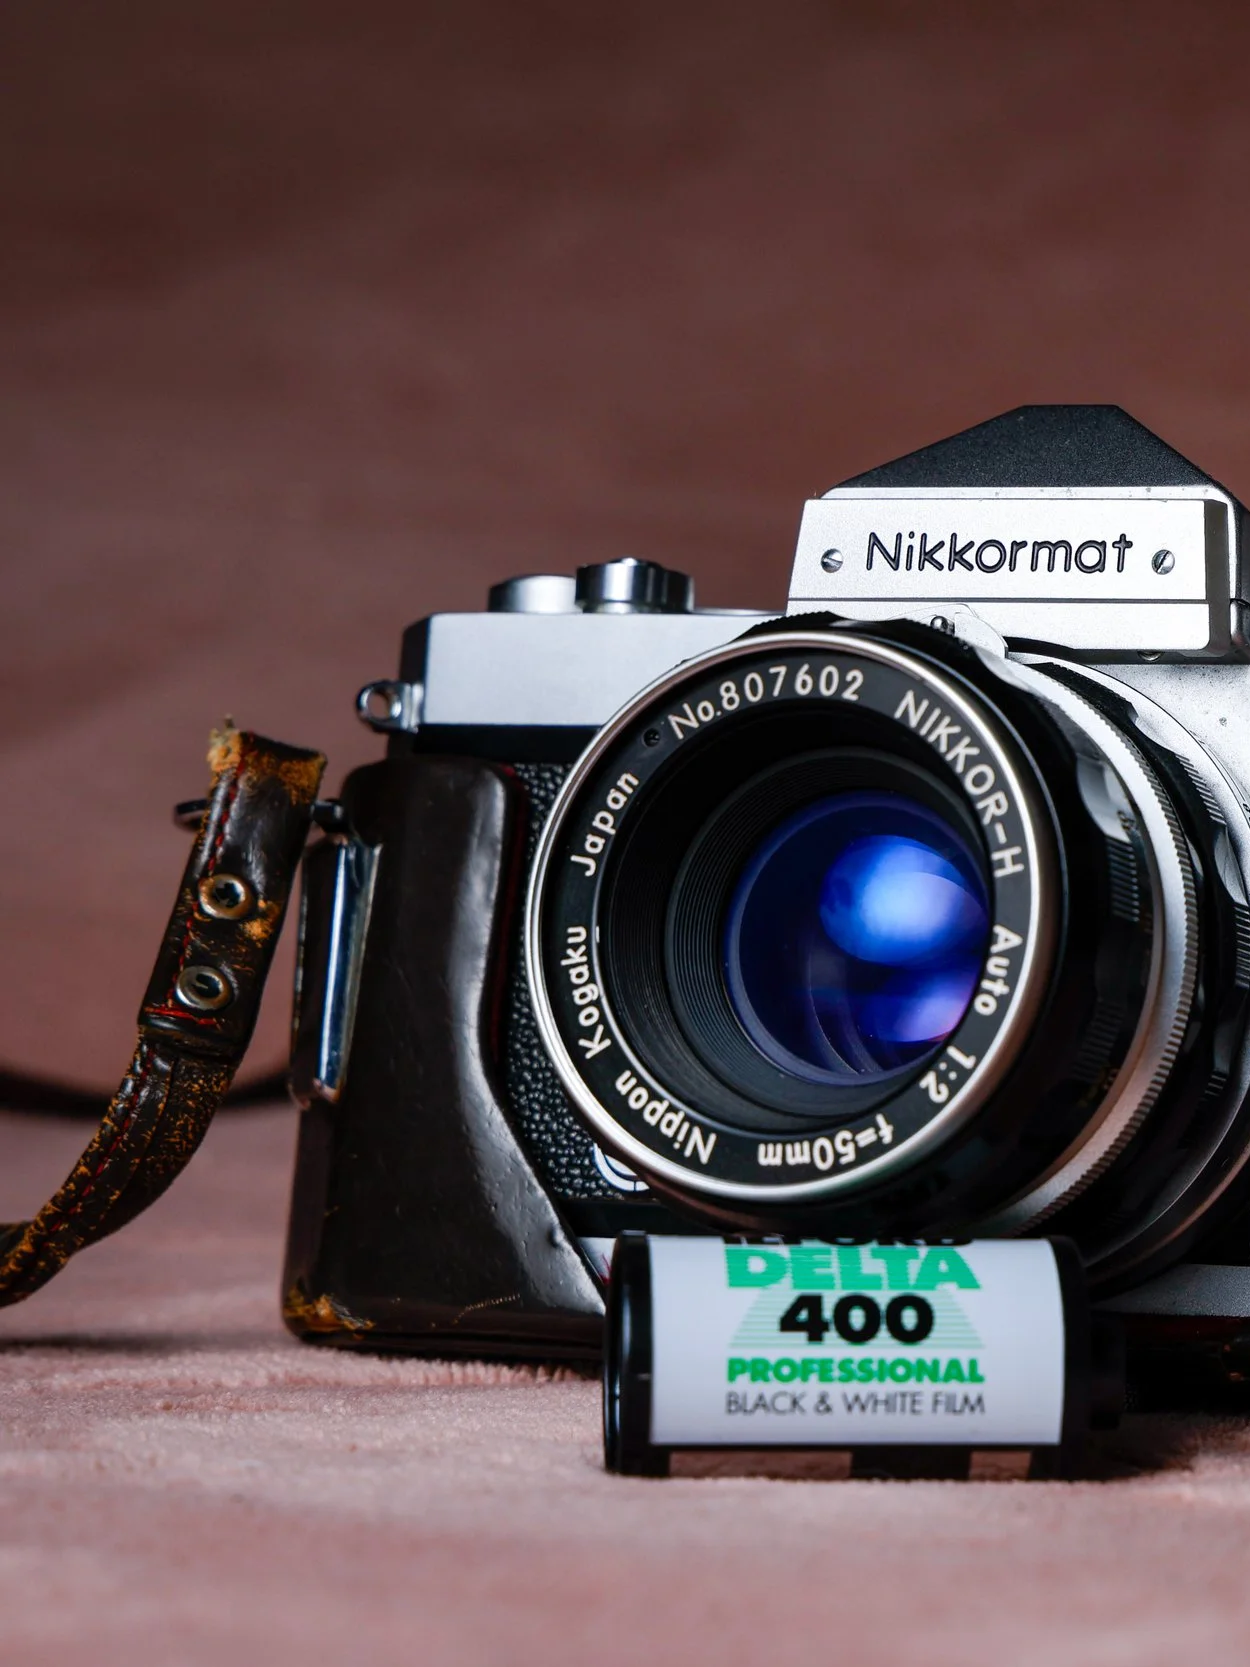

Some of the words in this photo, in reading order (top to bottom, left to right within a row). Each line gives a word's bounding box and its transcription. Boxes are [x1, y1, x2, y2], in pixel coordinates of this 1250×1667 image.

[866, 531, 1133, 573] Nikkormat
[666, 664, 865, 741] No.807602
[894, 689, 1025, 879] NIKKOR-H
[569, 771, 640, 878] Japan
[561, 925, 613, 1060] Kogaku
[973, 925, 1023, 1017] Auto
[918, 1045, 977, 1104] 1:2
[615, 1069, 717, 1165] Nippon
[758, 1112, 895, 1169] f=50mm
[725, 1245, 981, 1290] DELTA
[779, 1294, 934, 1345] 400
[727, 1357, 985, 1384] PROFESSIONAL
[725, 1391, 805, 1415] BLACK
[815, 1391, 833, 1415] &
[841, 1391, 924, 1415] WHITE
[932, 1391, 985, 1415] FILM
